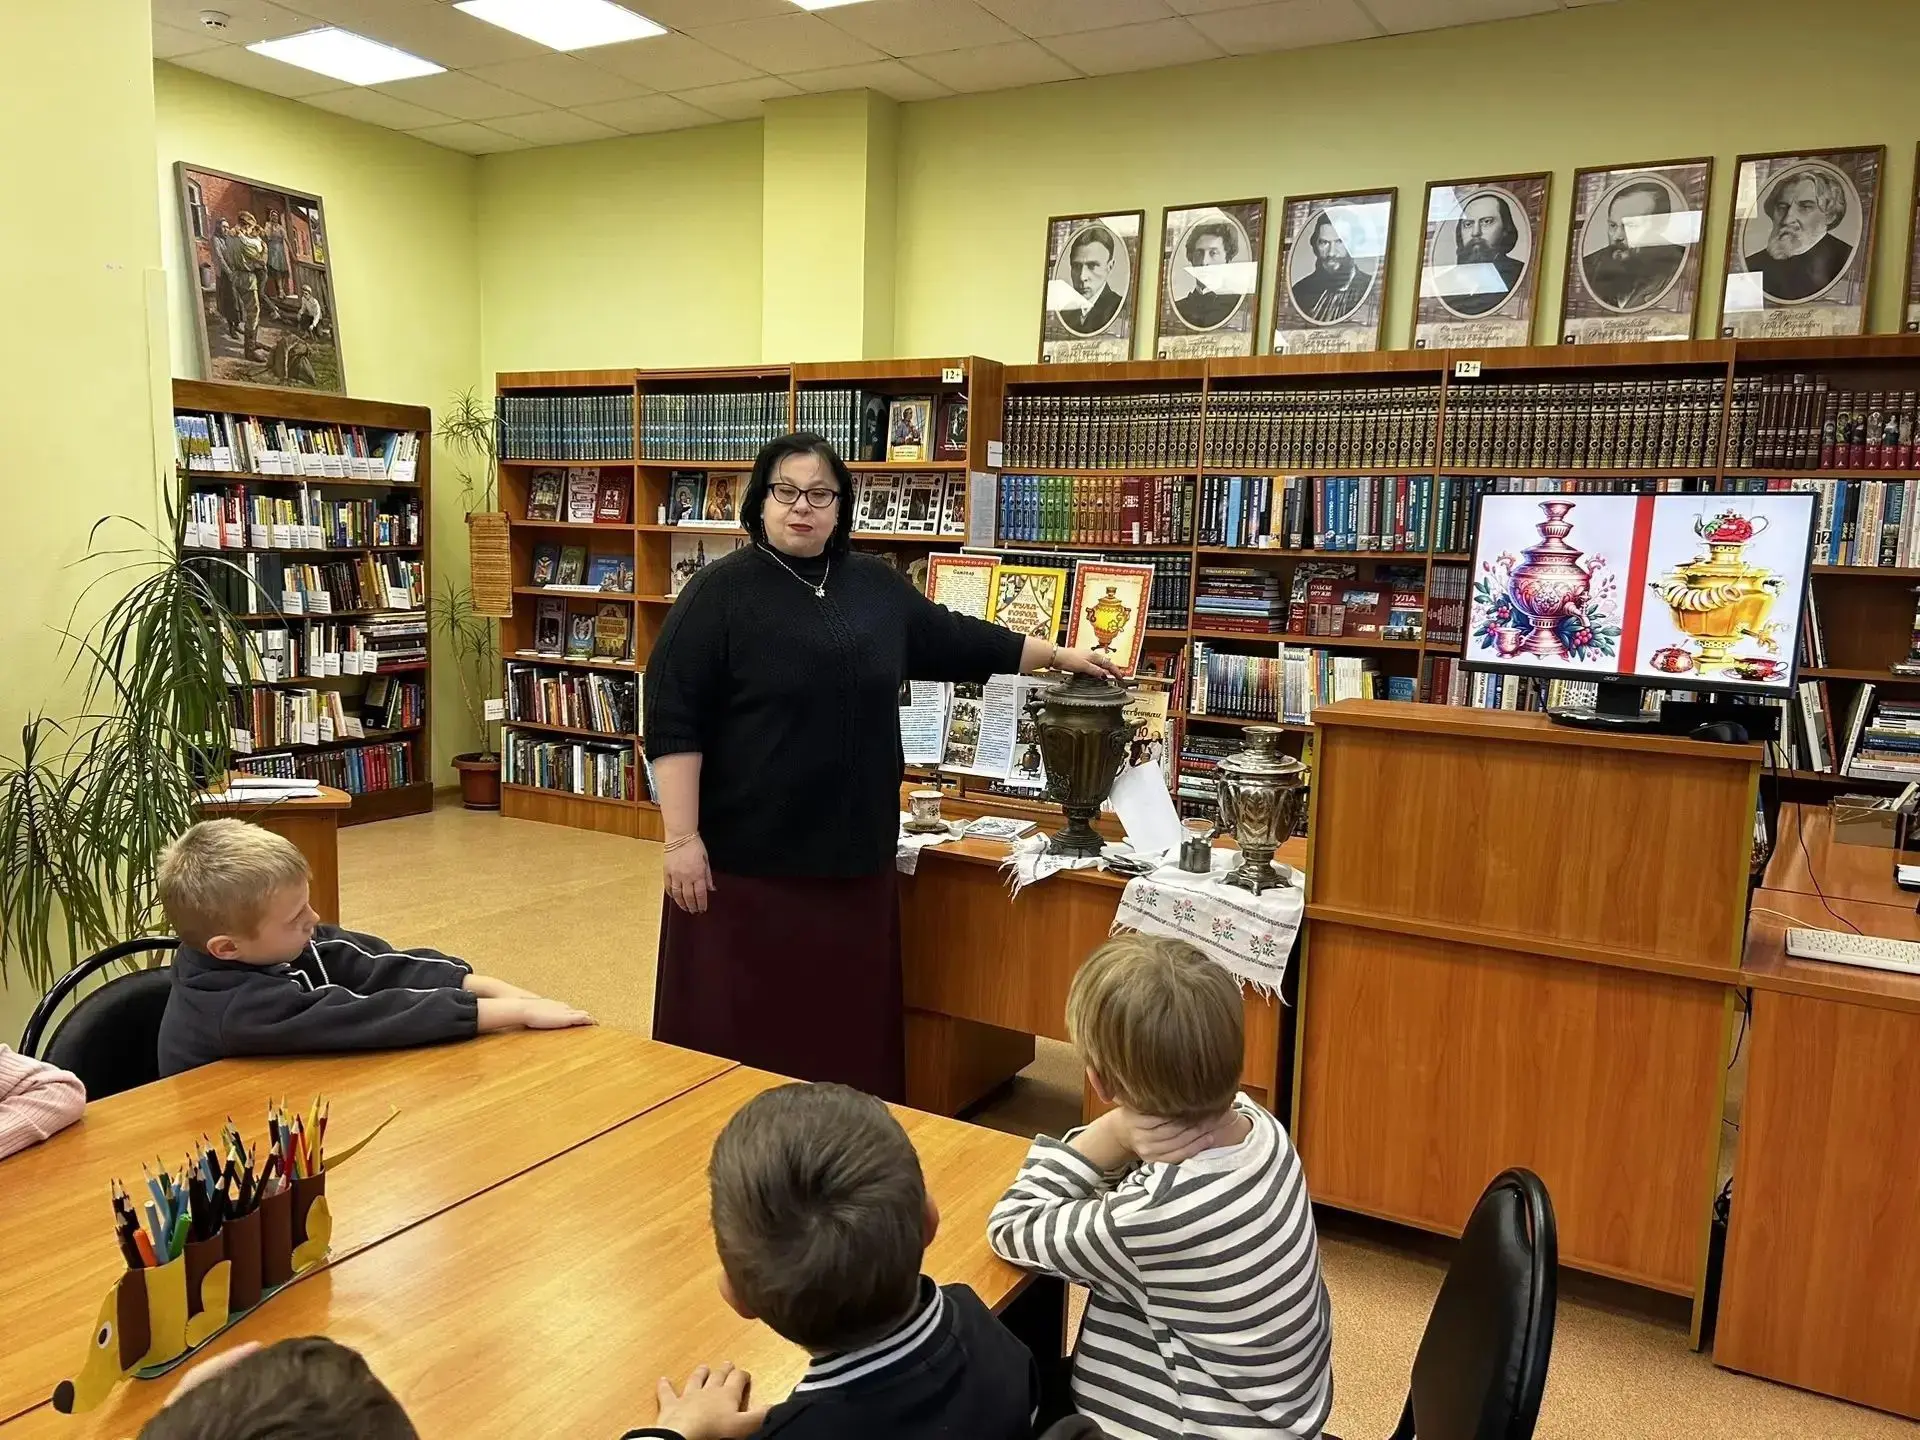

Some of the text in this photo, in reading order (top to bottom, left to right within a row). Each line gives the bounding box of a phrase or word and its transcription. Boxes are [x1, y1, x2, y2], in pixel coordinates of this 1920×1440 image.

[1457, 363, 1479, 374] 12+
[945, 370, 960, 380] 12+
[1823, 532, 1829, 543] 2
[1008, 610, 1038, 618] ГОРОД
